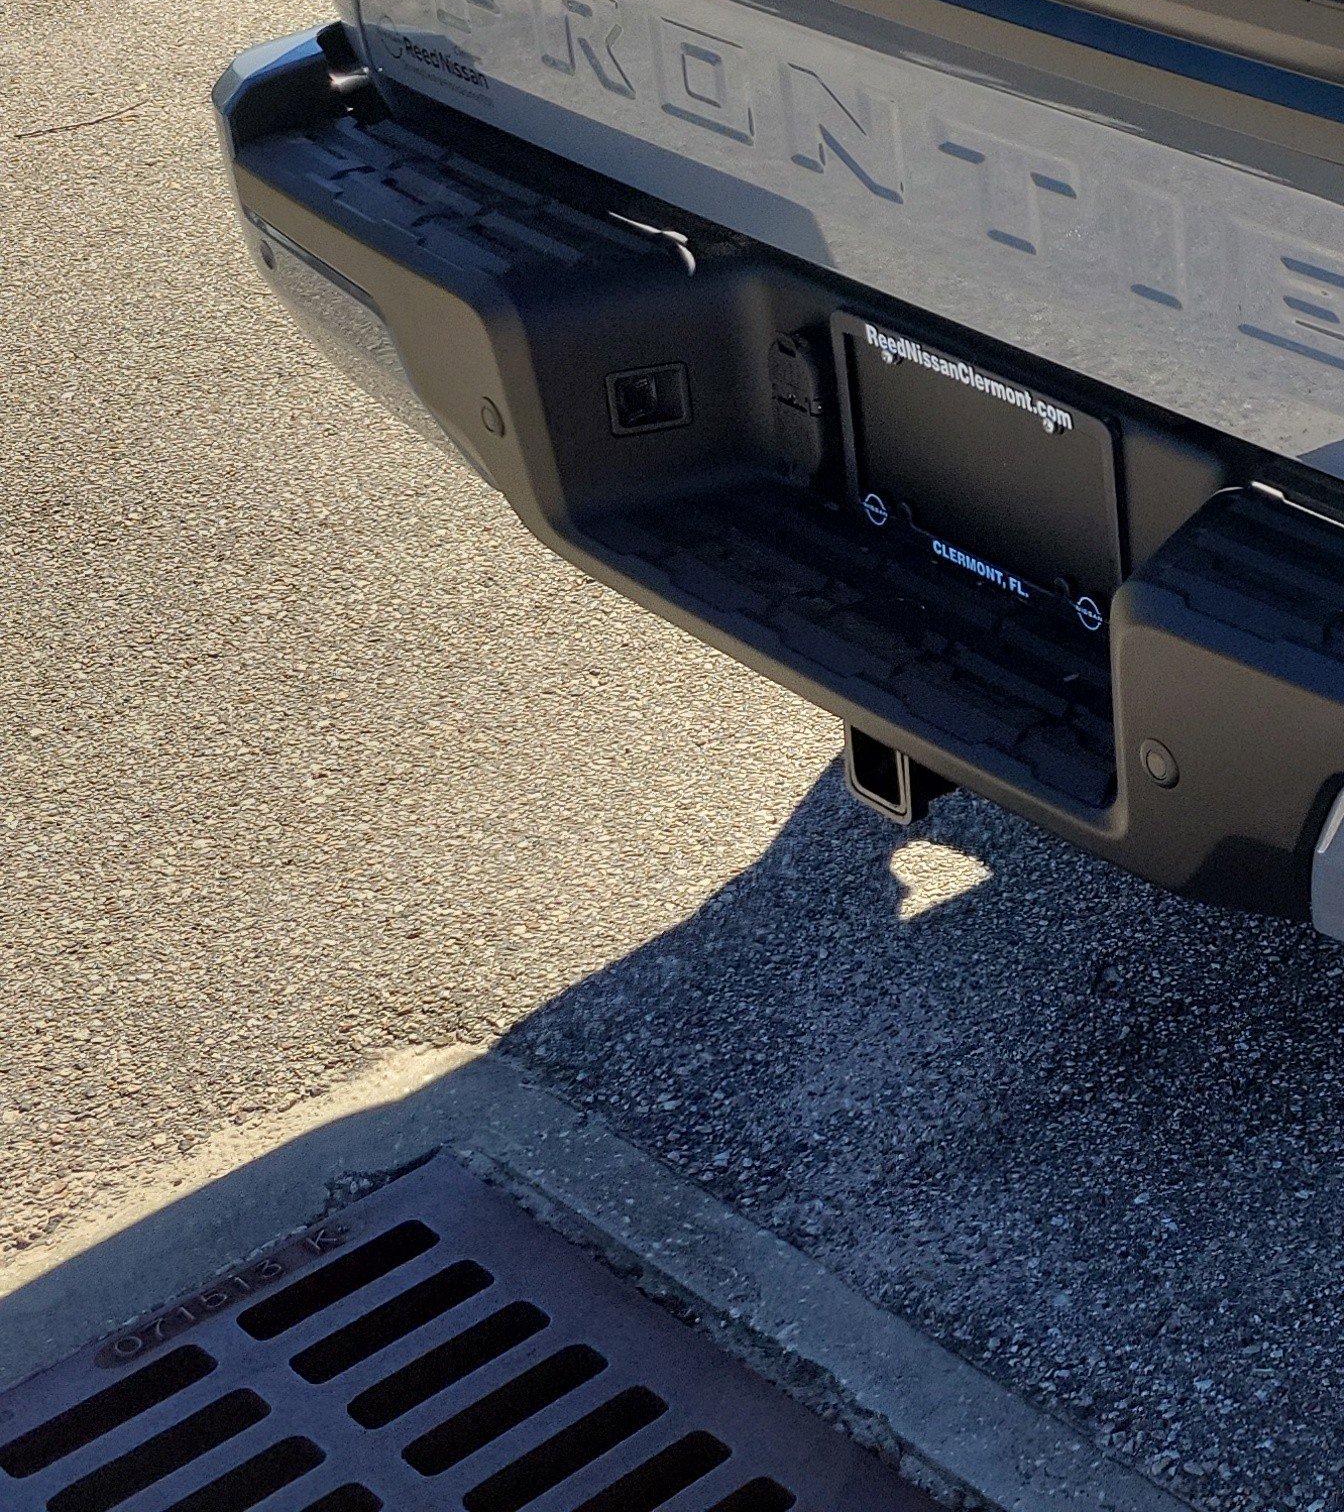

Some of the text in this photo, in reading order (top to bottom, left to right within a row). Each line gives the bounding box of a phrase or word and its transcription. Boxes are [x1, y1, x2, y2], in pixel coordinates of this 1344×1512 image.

[402, 36, 490, 90] ReedNissan
[865, 324, 1074, 430] ReedNissanClermont.com
[932, 539, 1006, 589] CLERMONT,
